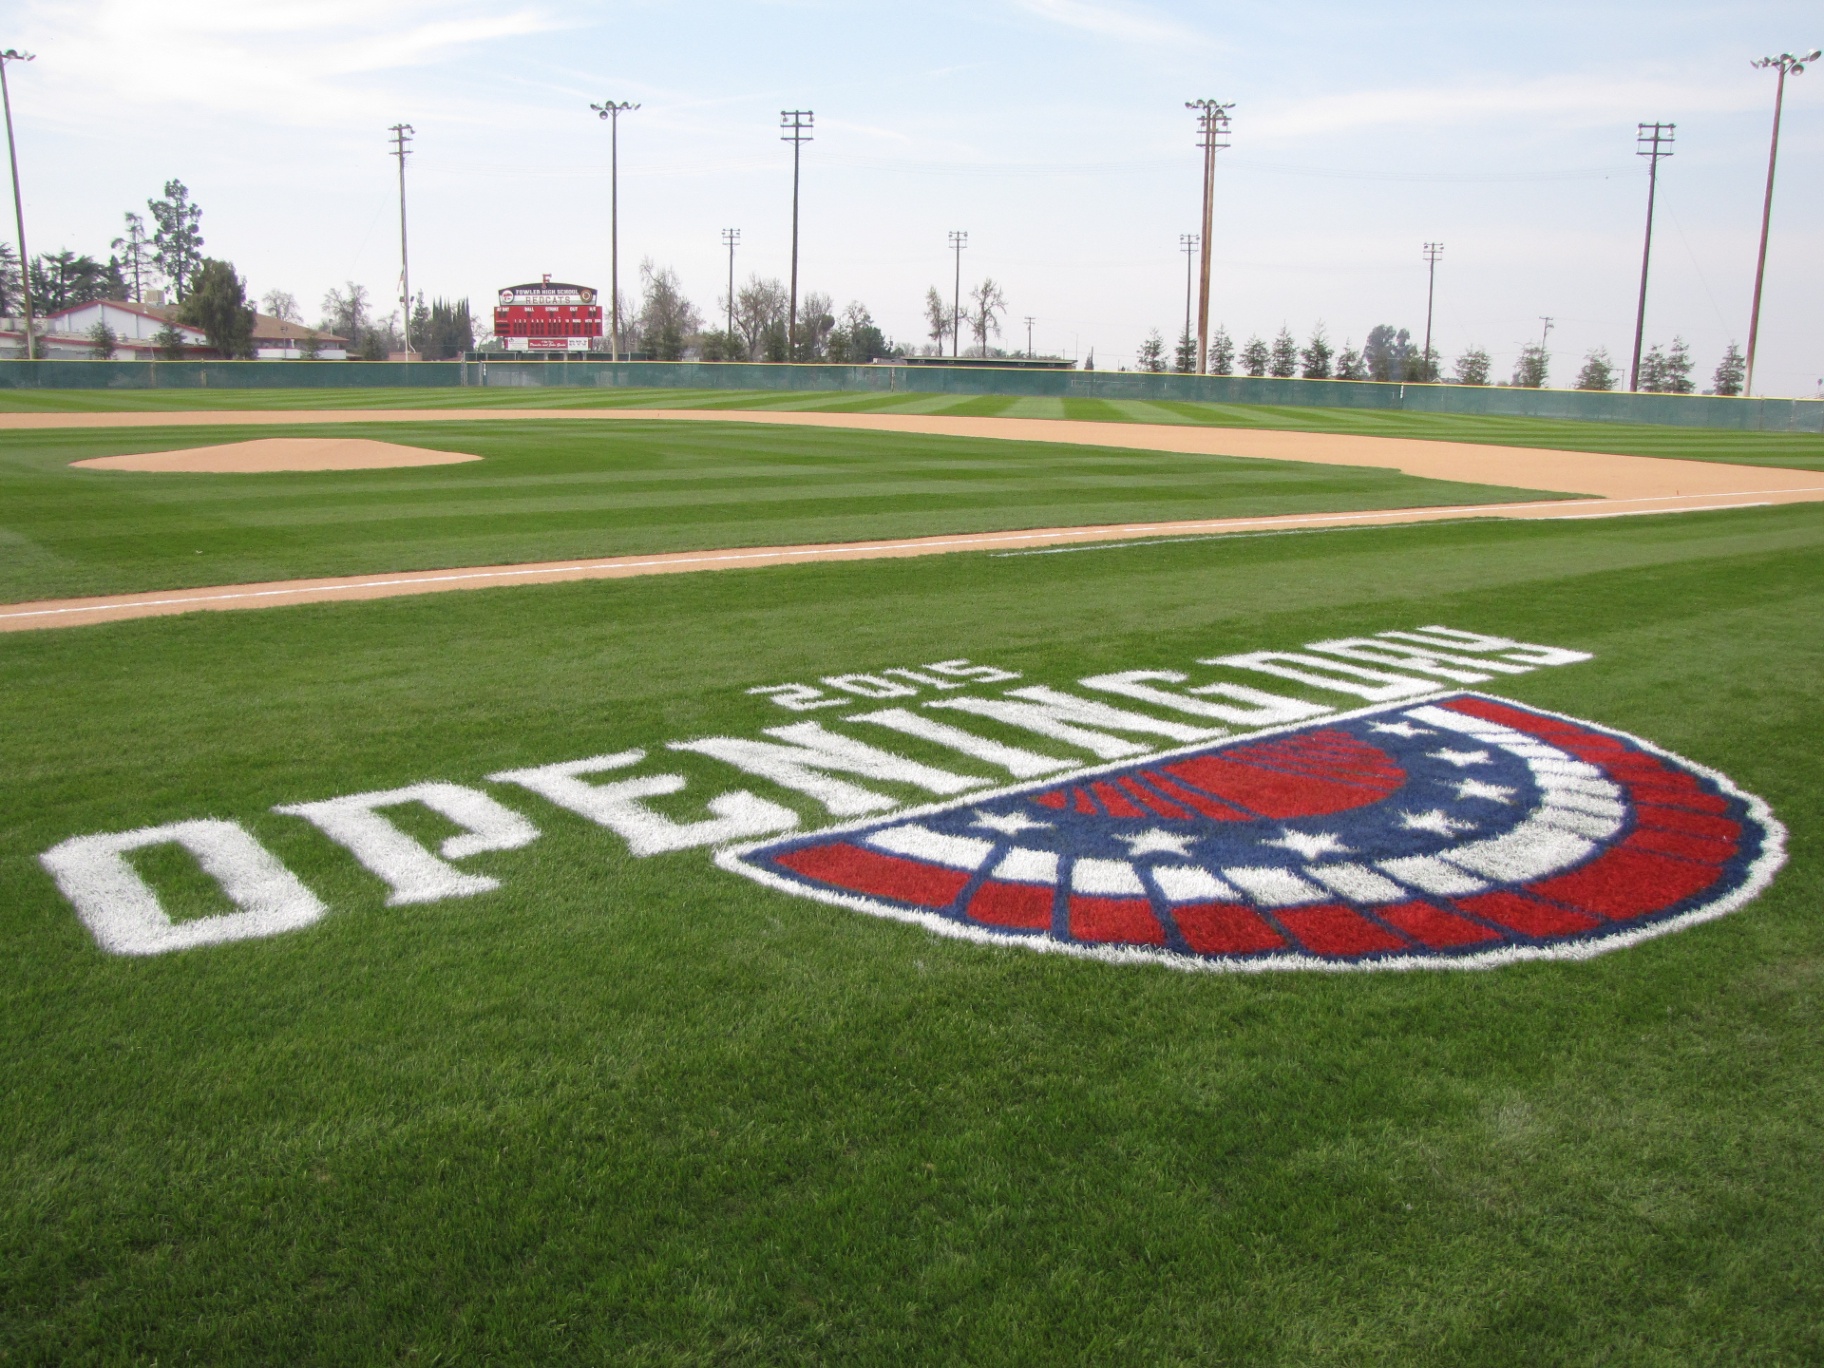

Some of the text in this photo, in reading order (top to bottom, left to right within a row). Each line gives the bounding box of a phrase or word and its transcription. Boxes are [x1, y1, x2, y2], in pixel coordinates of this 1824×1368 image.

[525, 296, 571, 304] REDCATS
[745, 658, 1023, 711] 2015
[40, 625, 1594, 955] OPENING DAY
